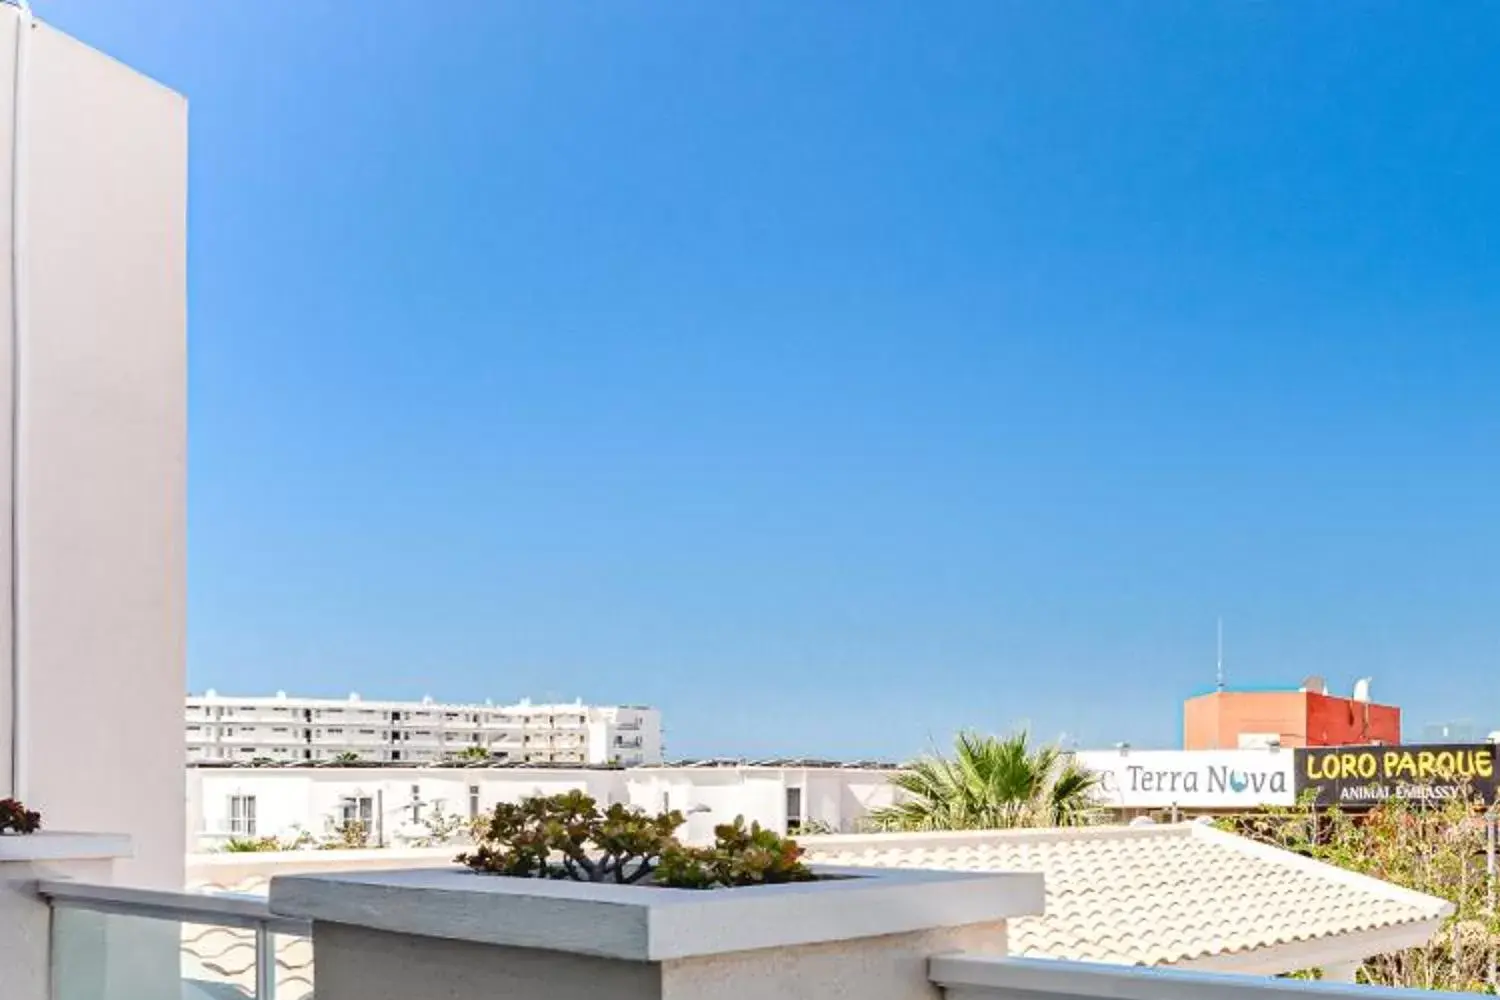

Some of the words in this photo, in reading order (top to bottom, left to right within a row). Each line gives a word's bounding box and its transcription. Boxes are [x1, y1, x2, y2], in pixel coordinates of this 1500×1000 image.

[1127, 765, 1199, 792] Terra
[1206, 765, 1288, 793] Nova
[1307, 752, 1377, 780] LORO
[1383, 750, 1494, 781] PARQUE
